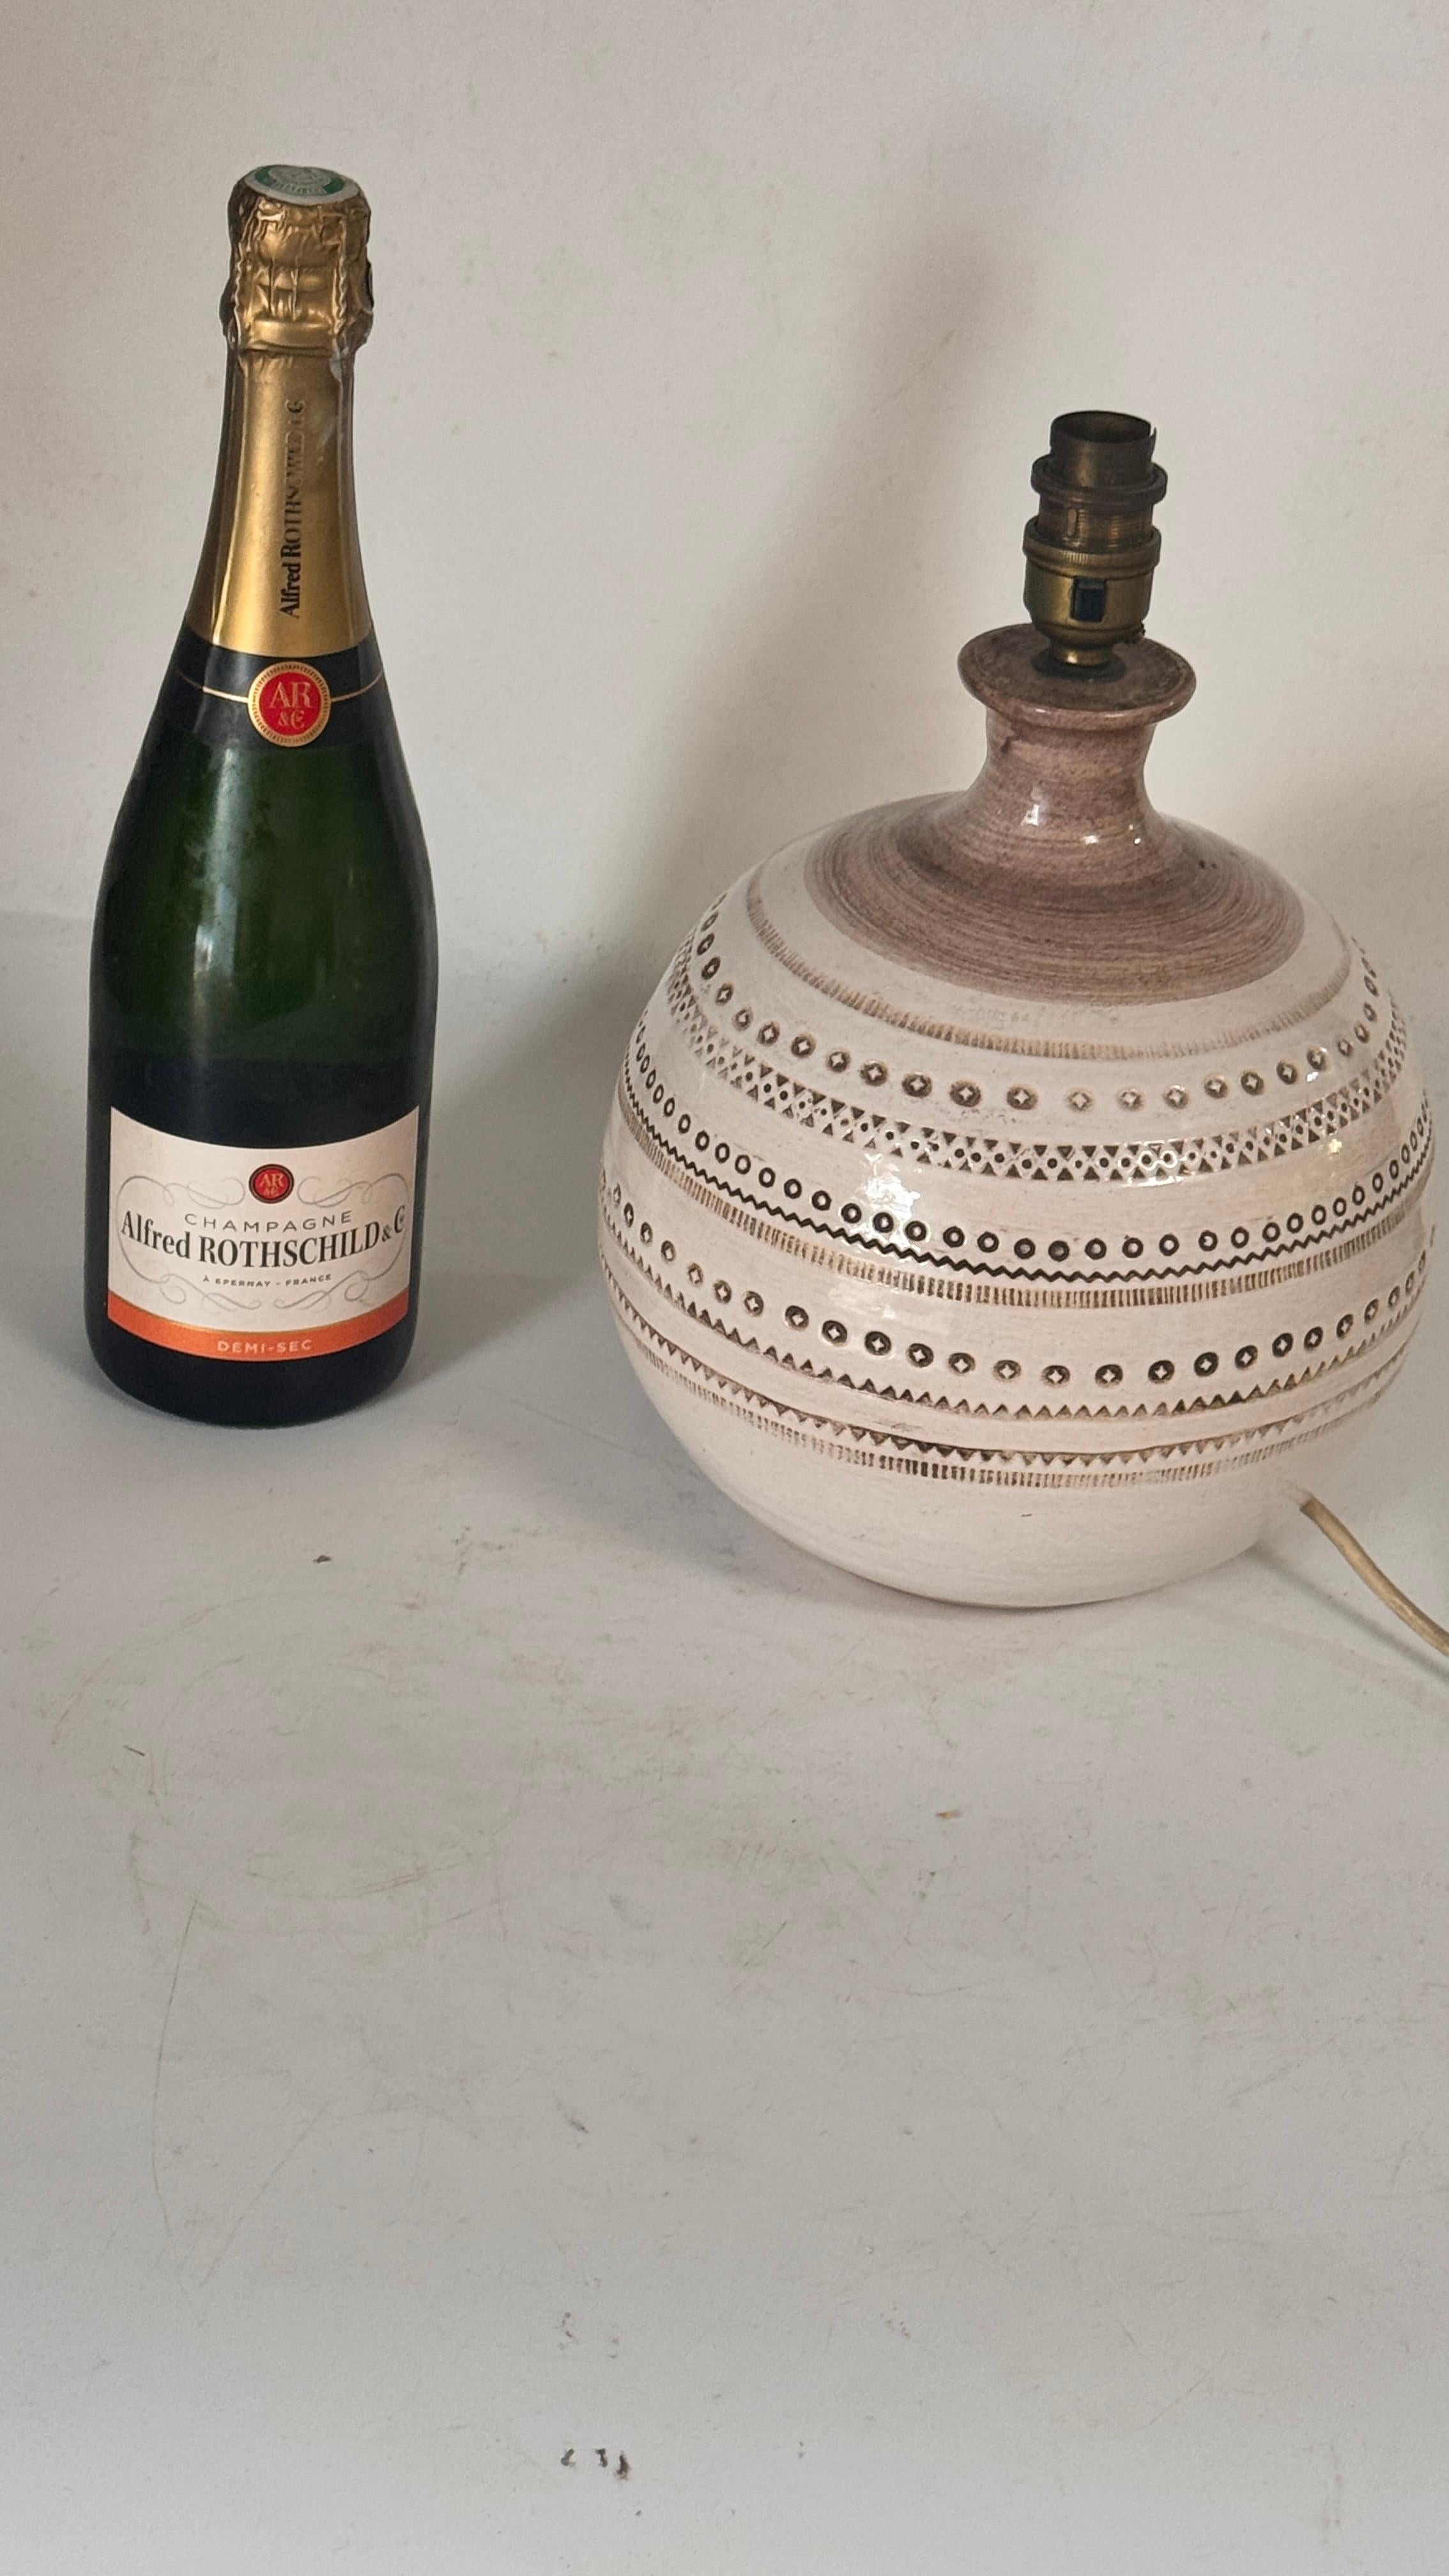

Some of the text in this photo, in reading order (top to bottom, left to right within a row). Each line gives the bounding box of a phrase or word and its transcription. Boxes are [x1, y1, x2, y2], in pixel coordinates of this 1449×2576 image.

[279, 562, 302, 618] Alfred
[268, 681, 312, 709] AR
[259, 1172, 285, 1188] AR
[185, 1210, 351, 1233] CHAMPAGNE
[121, 1210, 191, 1259] Alfred
[199, 1221, 379, 1268] ROTHSCHILD
[285, 1273, 332, 1287] FRANCE
[217, 1339, 312, 1354] DEMI-SEC
